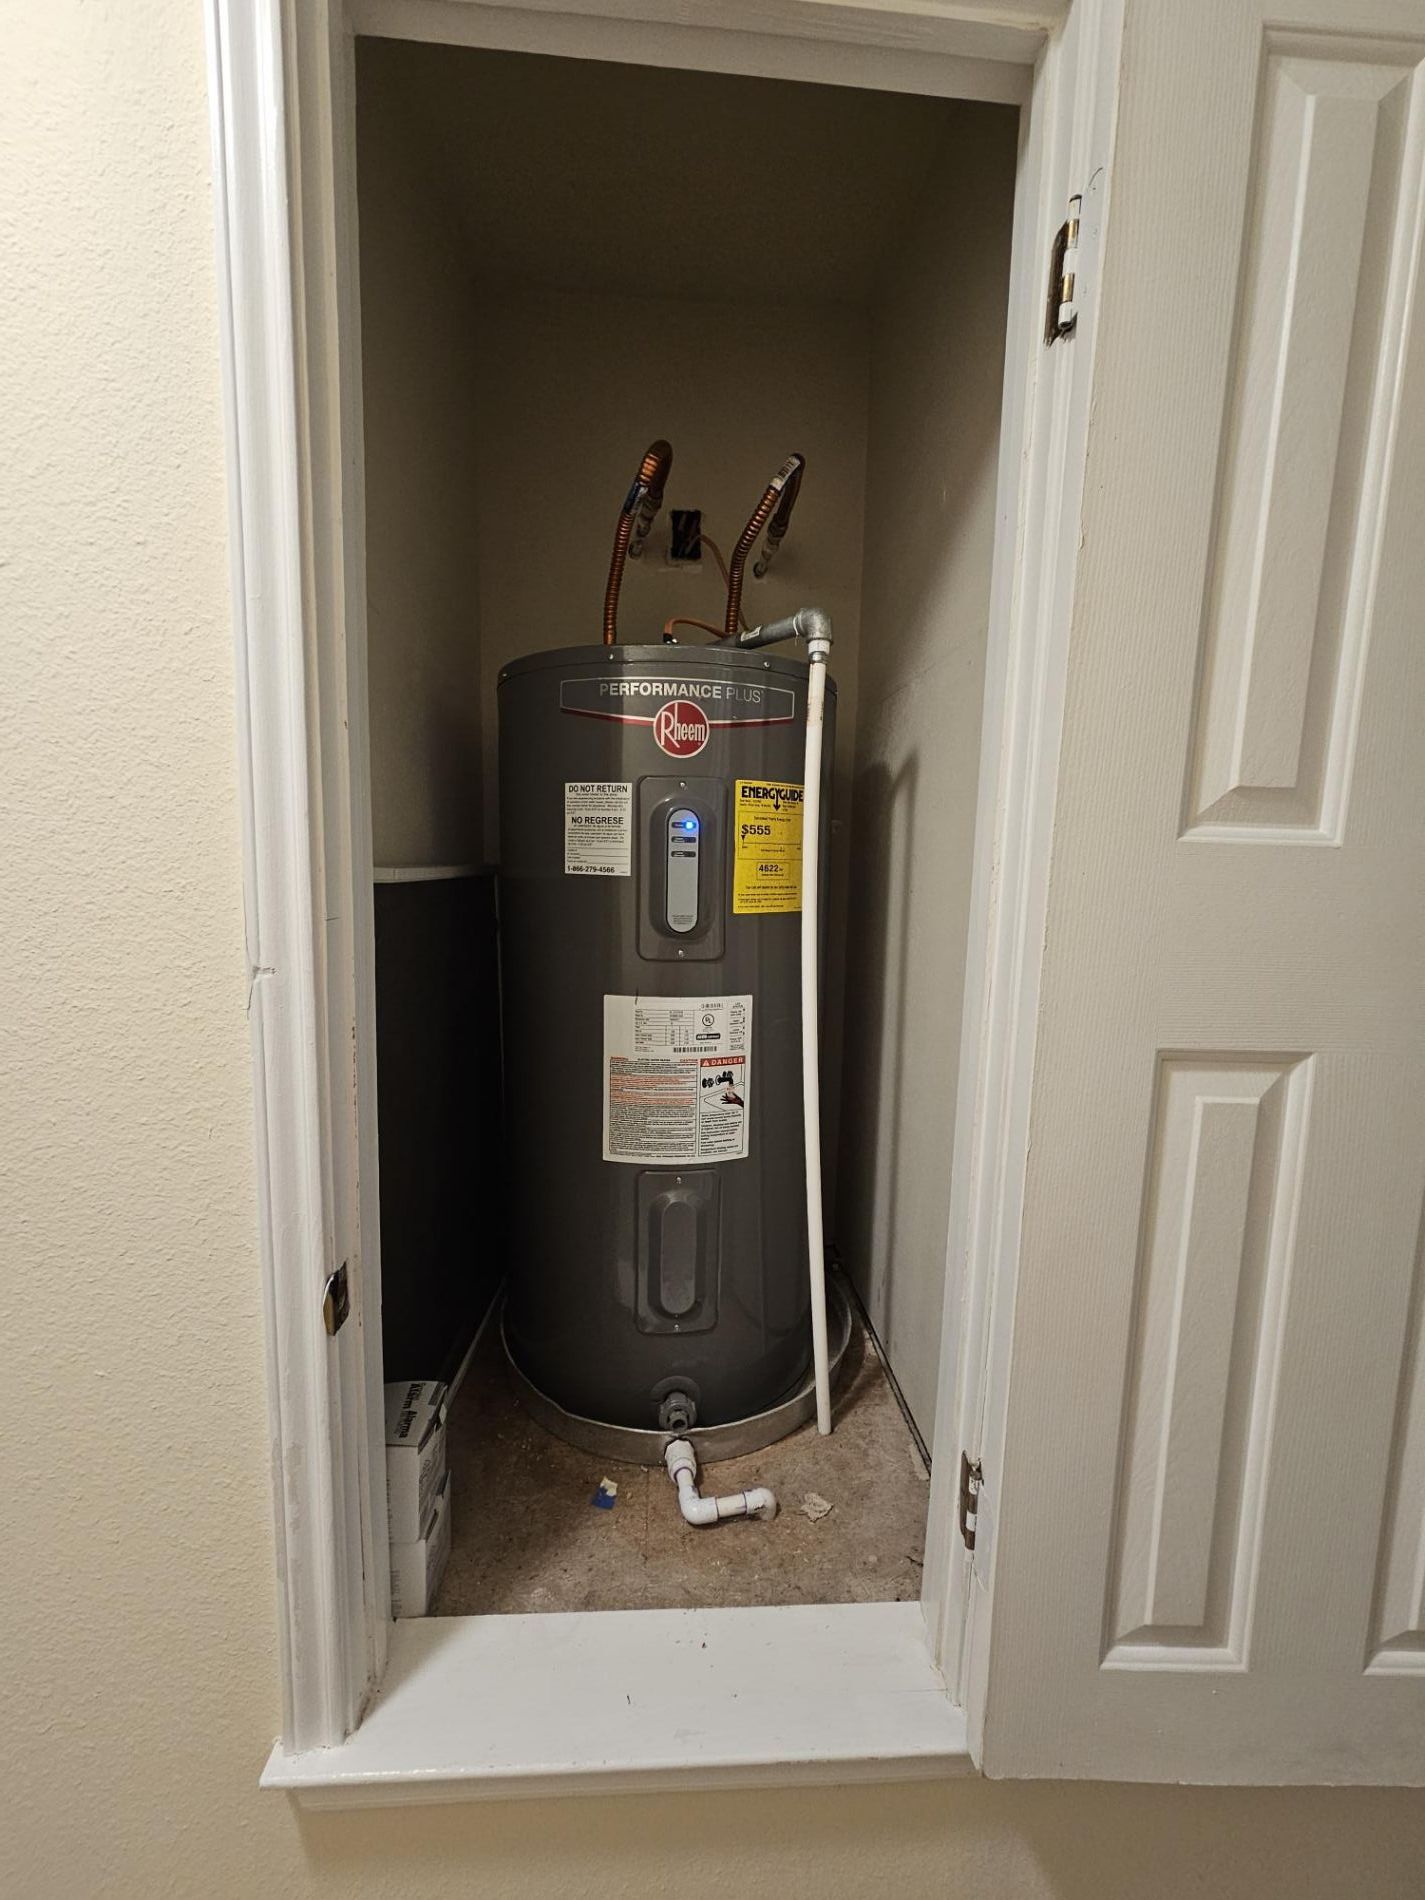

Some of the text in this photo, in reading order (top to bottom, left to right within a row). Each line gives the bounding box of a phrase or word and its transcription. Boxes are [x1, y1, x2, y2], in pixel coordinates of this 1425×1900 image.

[599, 682, 761, 703] PERFORMANCE PLUS
[660, 702, 706, 748] Rheem
[568, 785, 628, 793] DO NOT RETURN
[741, 786, 803, 802] ENERGYGUIDE
[571, 816, 624, 825] NO REGRESE
[741, 824, 771, 836] $555
[711, 1057, 744, 1065] DANGER
